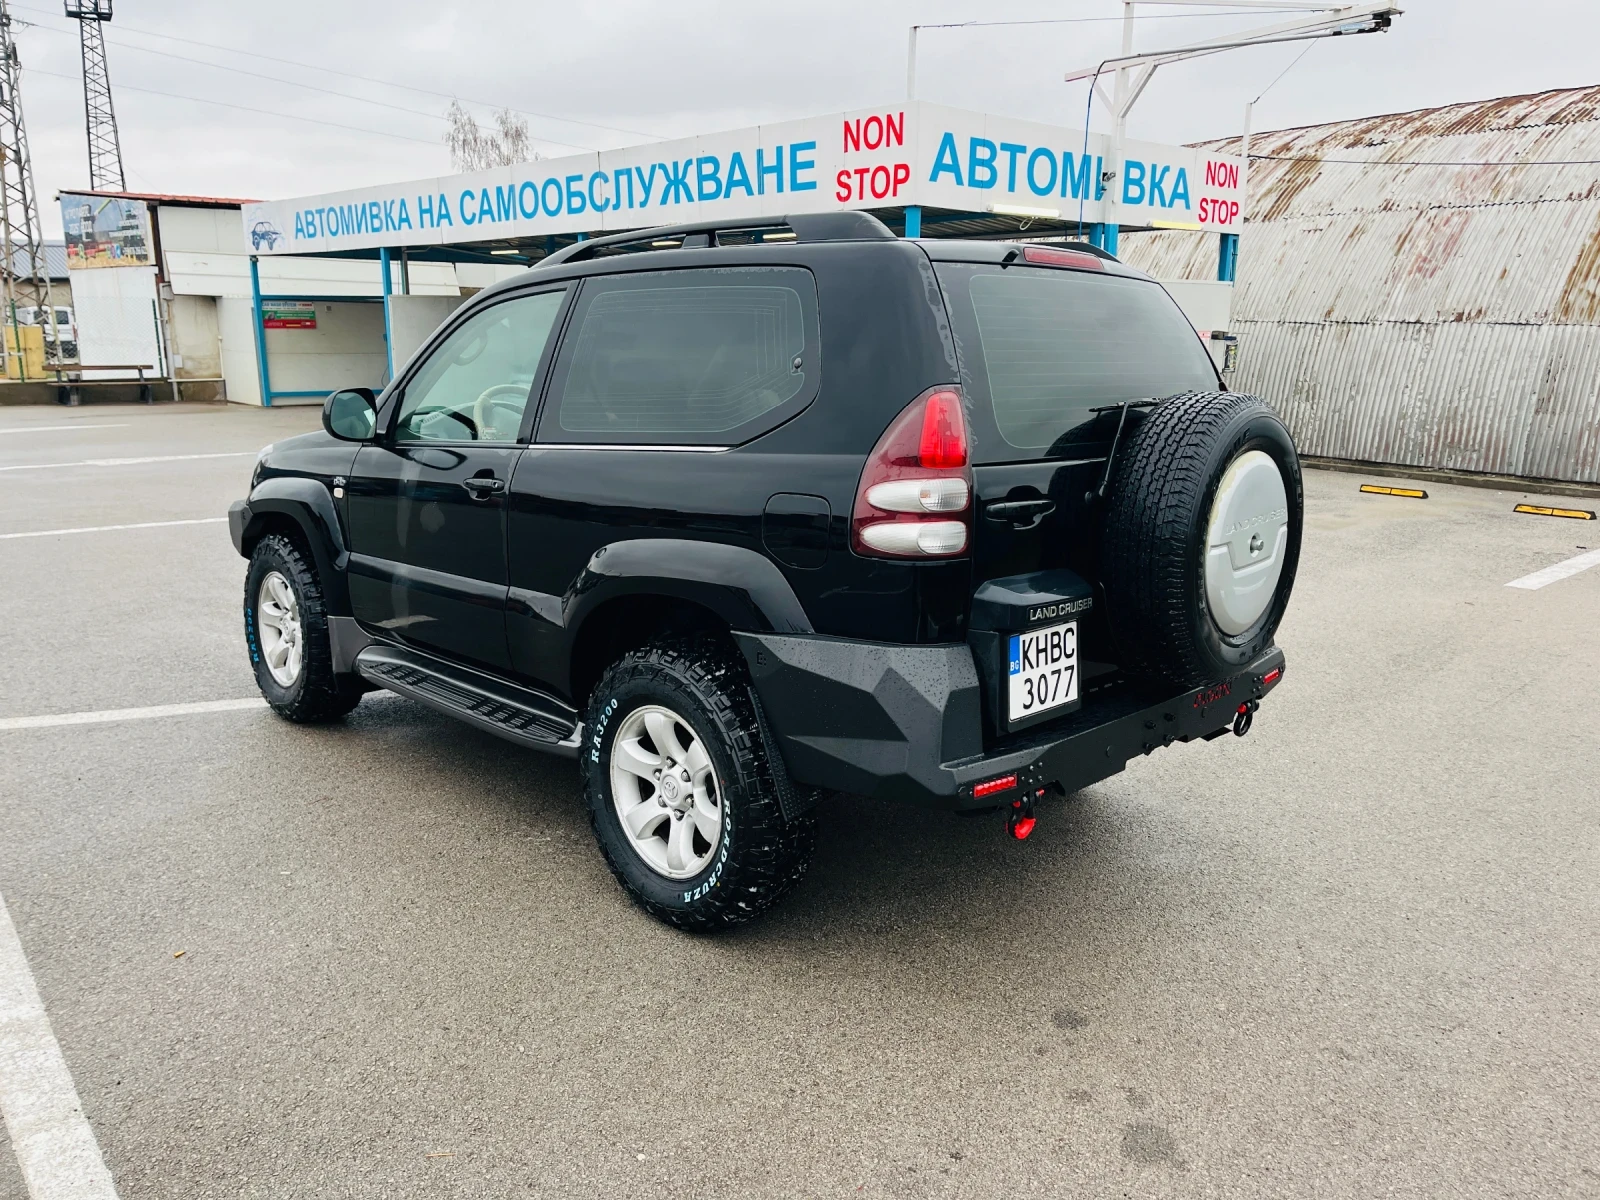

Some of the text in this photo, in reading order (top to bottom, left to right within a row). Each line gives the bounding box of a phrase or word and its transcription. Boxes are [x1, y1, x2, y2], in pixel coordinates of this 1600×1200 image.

[844, 112, 904, 153] NON
[294, 141, 817, 240] АВТОМИВКА НА САМООБСЛУЖВАНЕ
[835, 163, 910, 203] STOP
[1205, 160, 1239, 190] NON
[1198, 198, 1240, 225] STOP
[1029, 597, 1093, 621] LAND CRUISER
[1010, 660, 1020, 672] BG
[1022, 627, 1075, 672] KHBC
[1022, 664, 1075, 710] 3077
[591, 698, 618, 763] RA3200
[683, 799, 731, 903] ROADCRUZA
